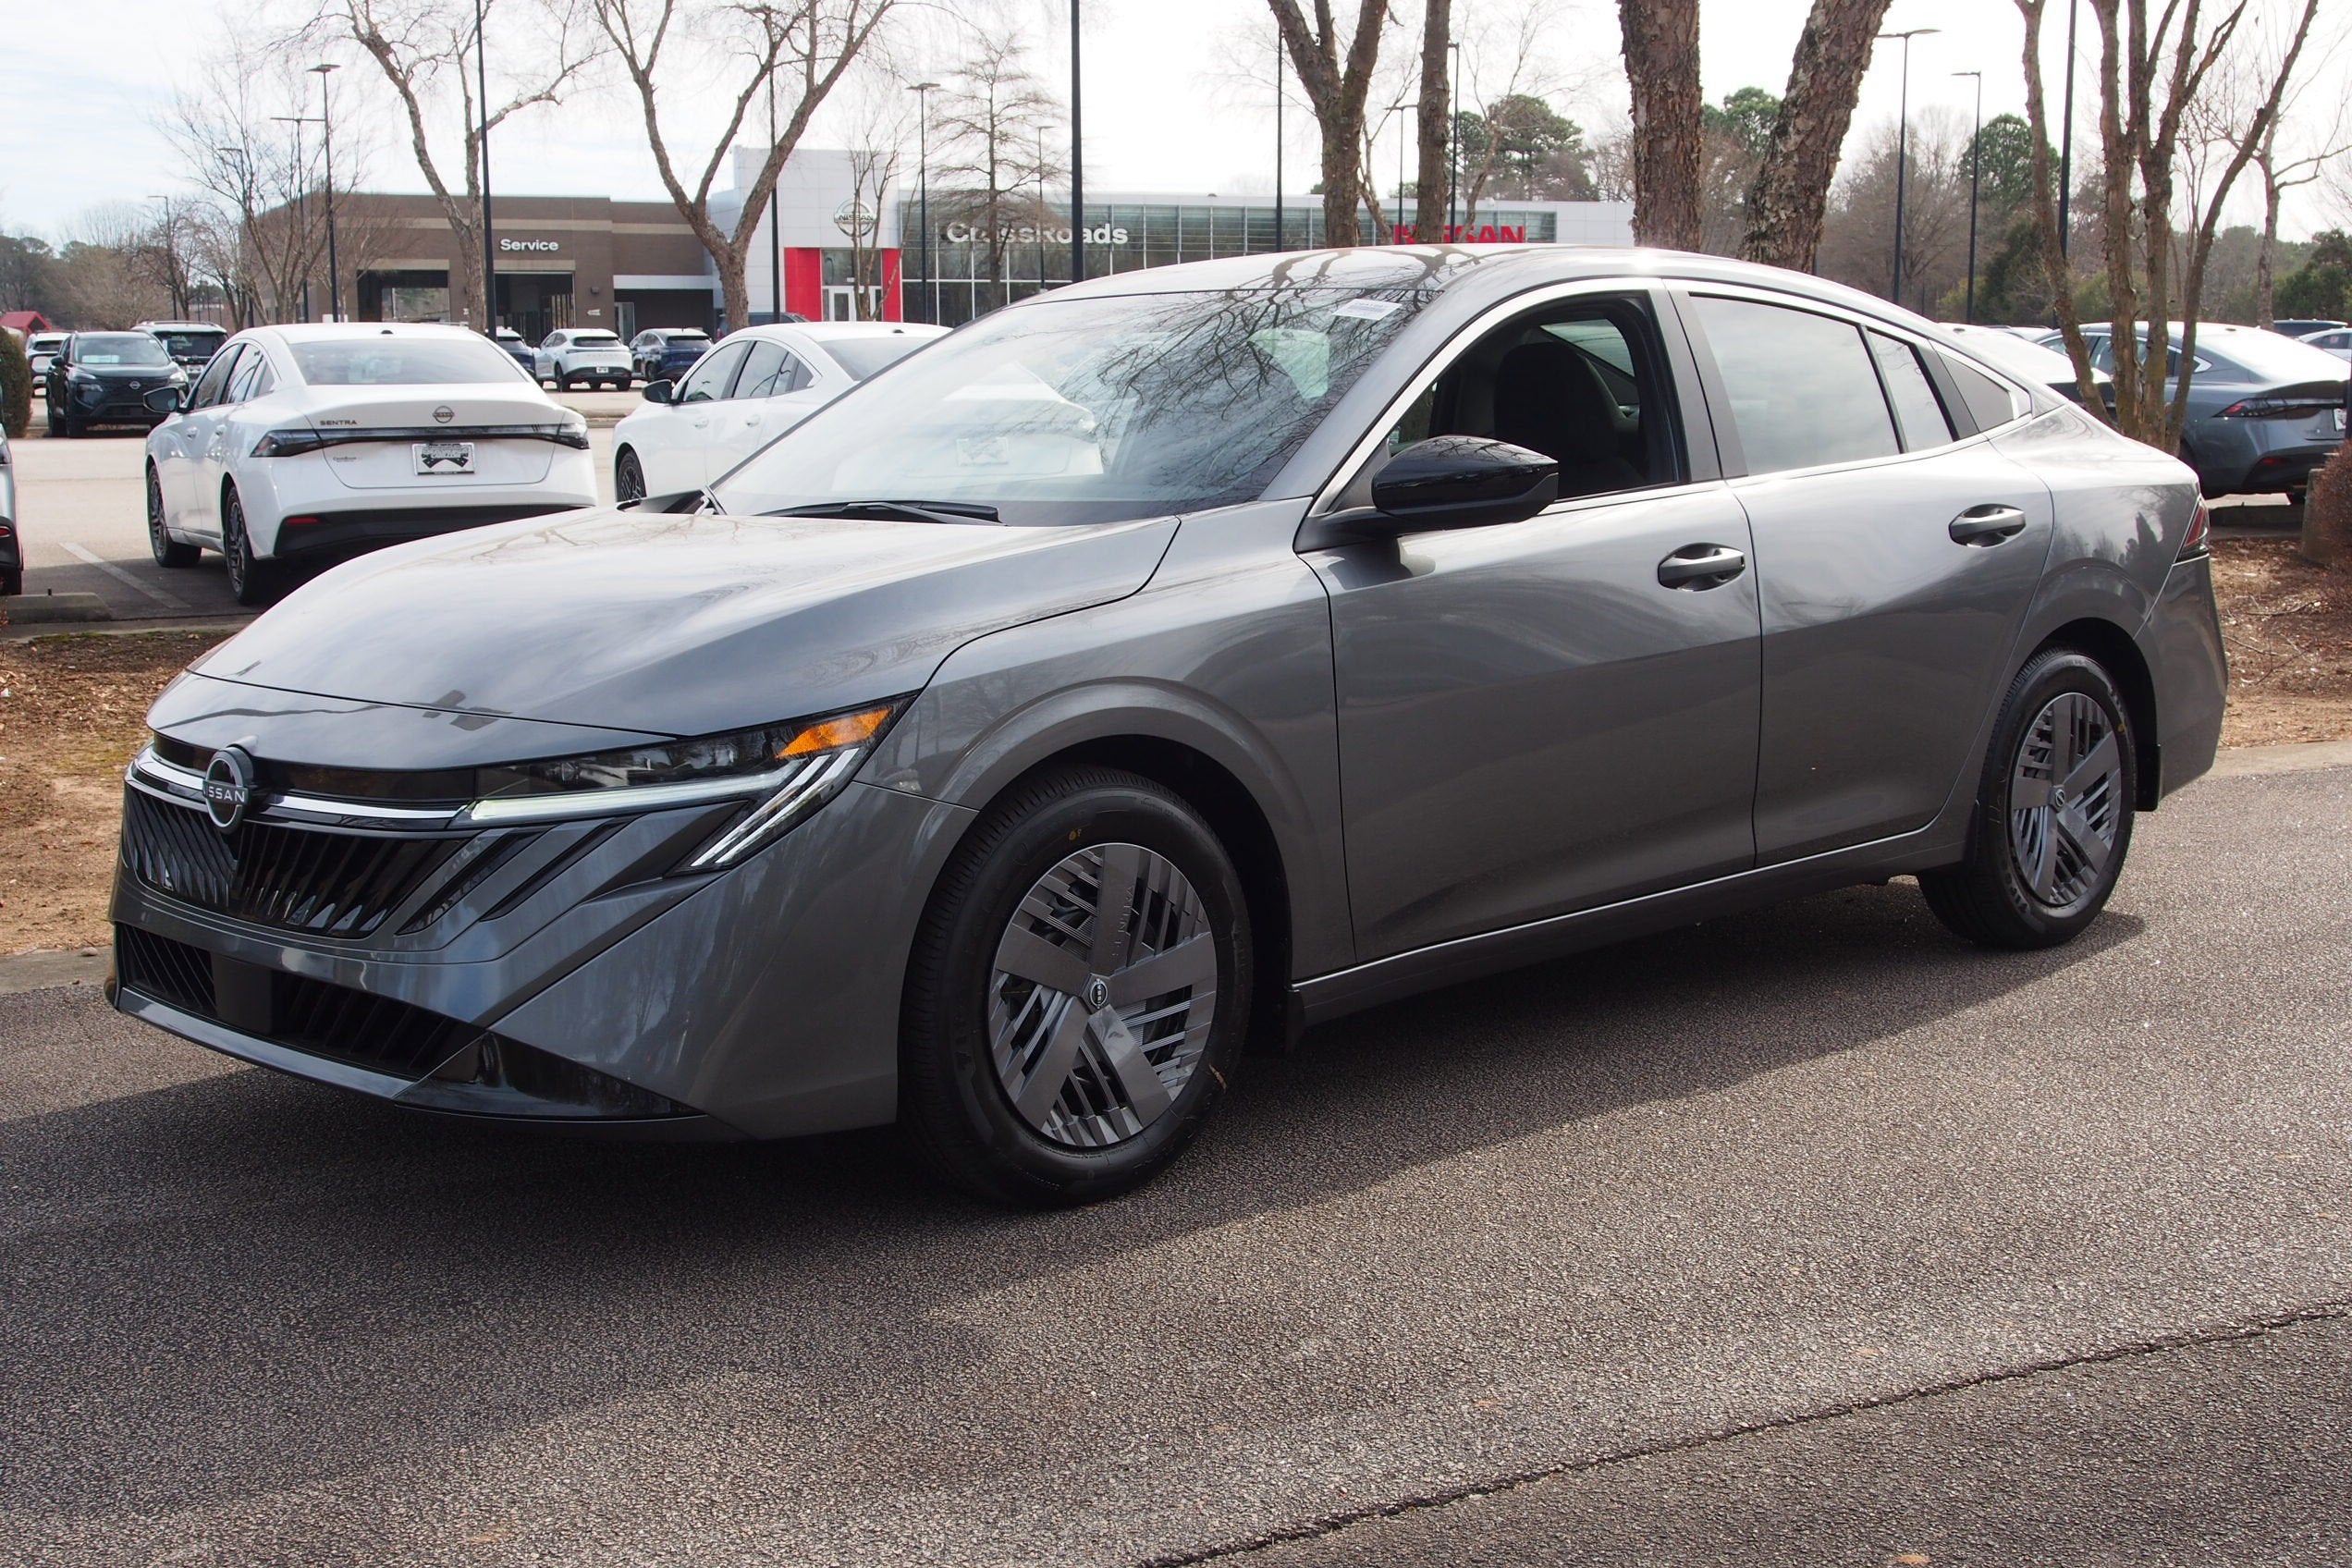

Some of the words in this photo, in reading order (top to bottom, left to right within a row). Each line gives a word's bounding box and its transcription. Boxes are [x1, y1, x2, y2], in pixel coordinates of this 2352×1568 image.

[1393, 224, 1525, 244] NSAN
[500, 239, 559, 251] Service
[204, 786, 245, 802] SSAN
